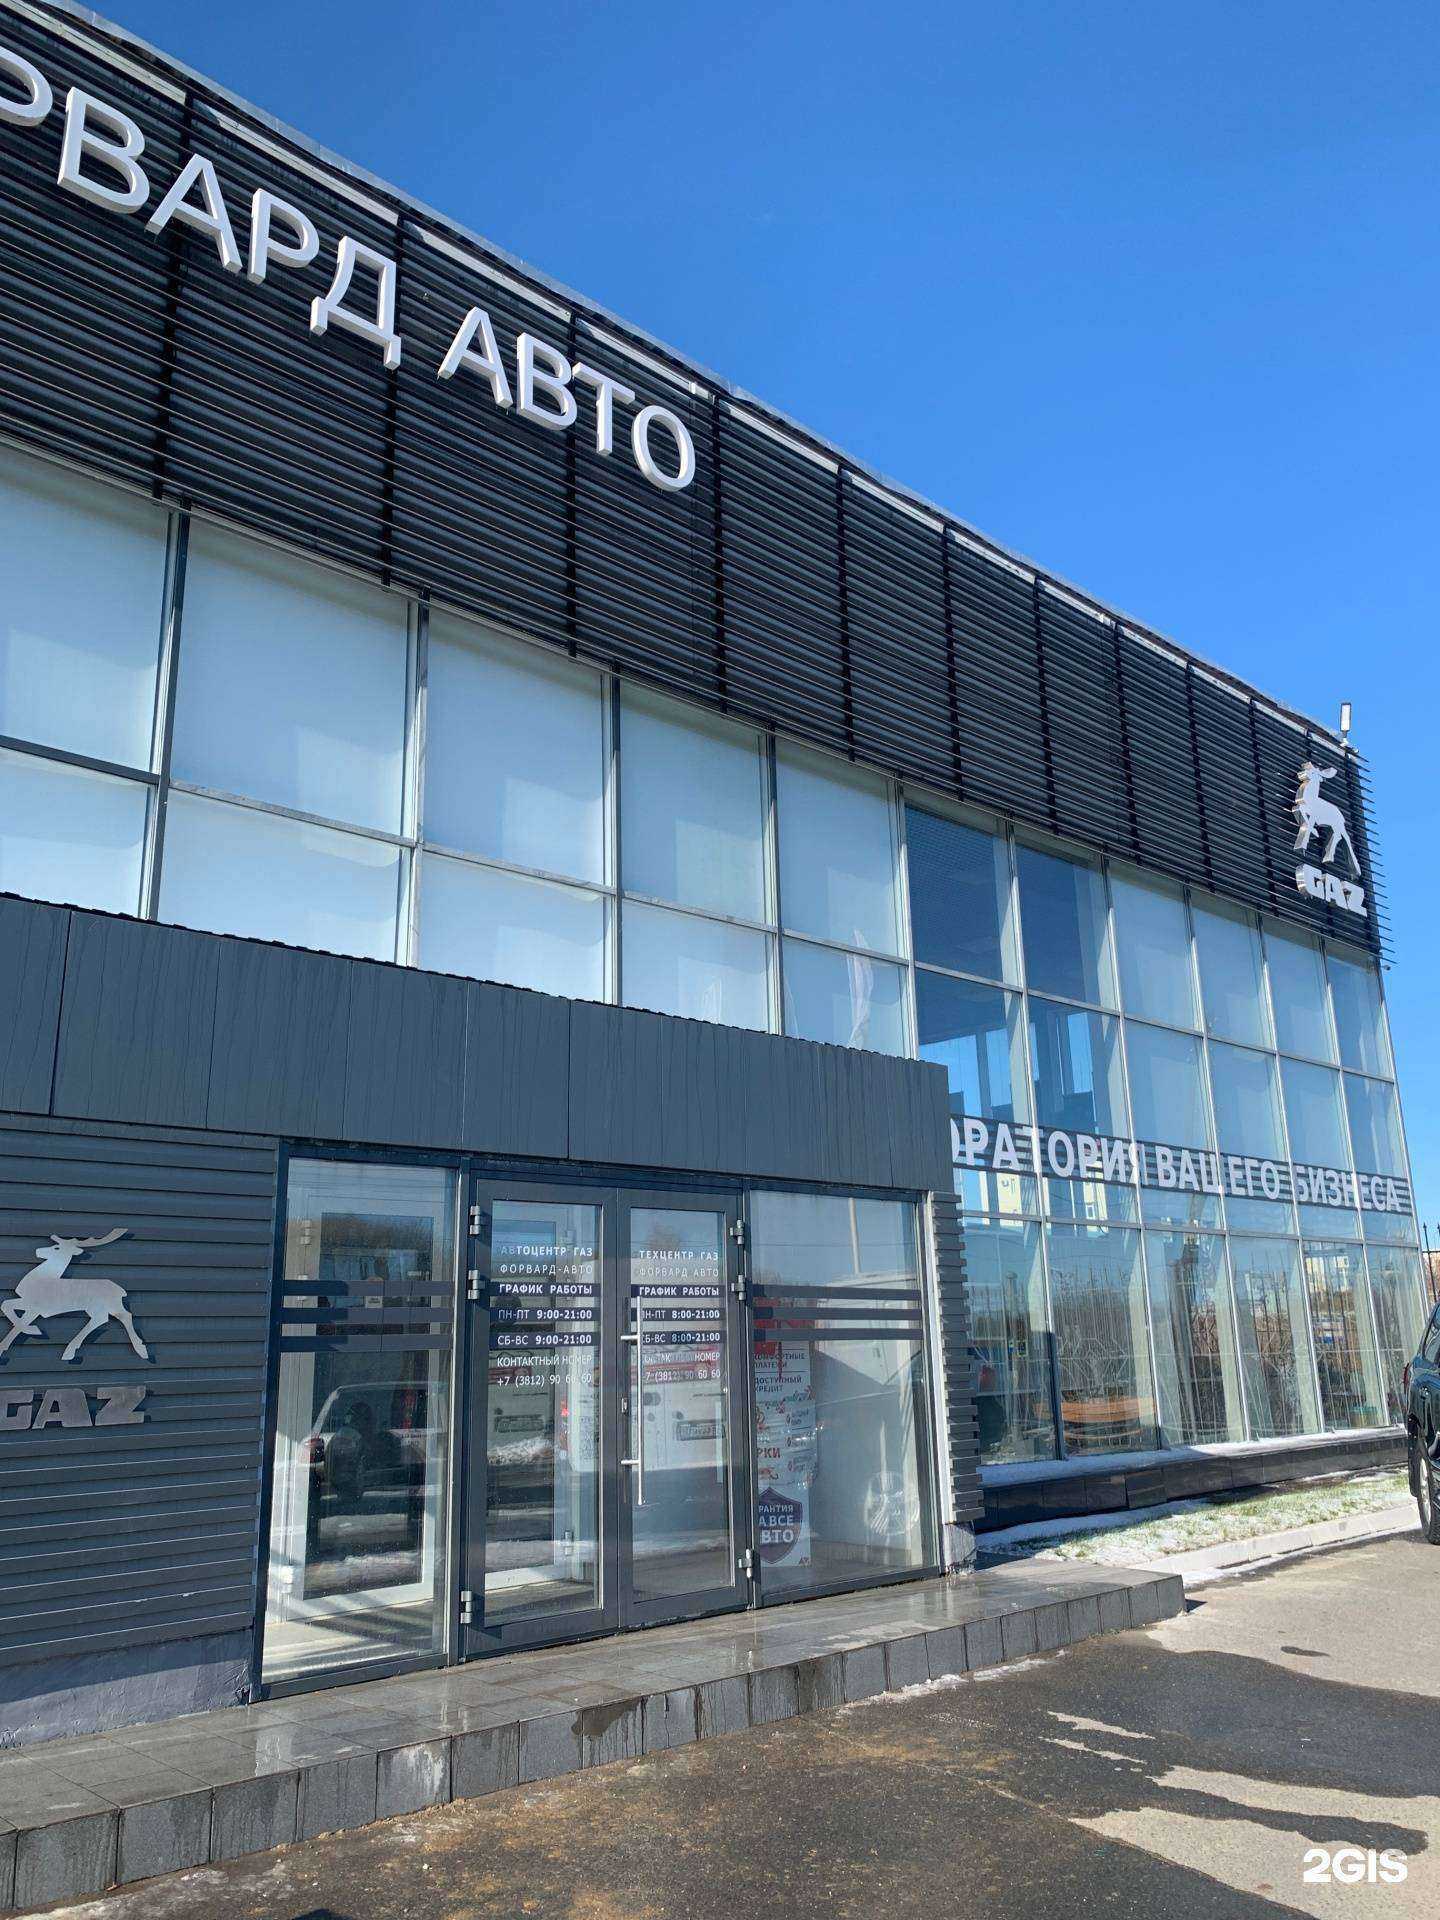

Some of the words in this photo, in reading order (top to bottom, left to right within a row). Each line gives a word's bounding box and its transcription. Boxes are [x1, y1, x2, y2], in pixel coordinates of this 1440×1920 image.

[438, 307, 696, 491] АВТО
[1296, 863, 1368, 917] GAZ
[1295, 1165, 1402, 1212] БИЗНЕСА
[501, 1245, 566, 1256] АВТОЦЕНТР
[574, 1247, 593, 1257] ГАЗ
[640, 1250, 694, 1260] ТЕХЦЕНТР
[701, 1252, 719, 1261] ГАЗ
[499, 1284, 543, 1294] ГРАФИК
[550, 1284, 593, 1294] РАБОТЫ
[640, 1287, 677, 1296] ГРАФИК
[683, 1287, 719, 1296] РАБОТЫ
[498, 1309, 530, 1319] ПН-ПТ
[537, 1309, 593, 1319] 9:00-21:00
[671, 1309, 720, 1319] 8:00-21:00
[497, 1335, 529, 1345] СБ-ВС
[535, 1334, 592, 1344] 9:00-21:00
[671, 1332, 720, 1342] 8:00-21:00
[497, 1355, 560, 1367] КОНТАКТНЫЙ
[694, 1352, 720, 1362] НОМЕР
[497, 1375, 511, 1386] +7
[515, 1374, 545, 1388] (3812)
[549, 1373, 561, 1384] 90
[0, 1385, 146, 1431] GAZ
